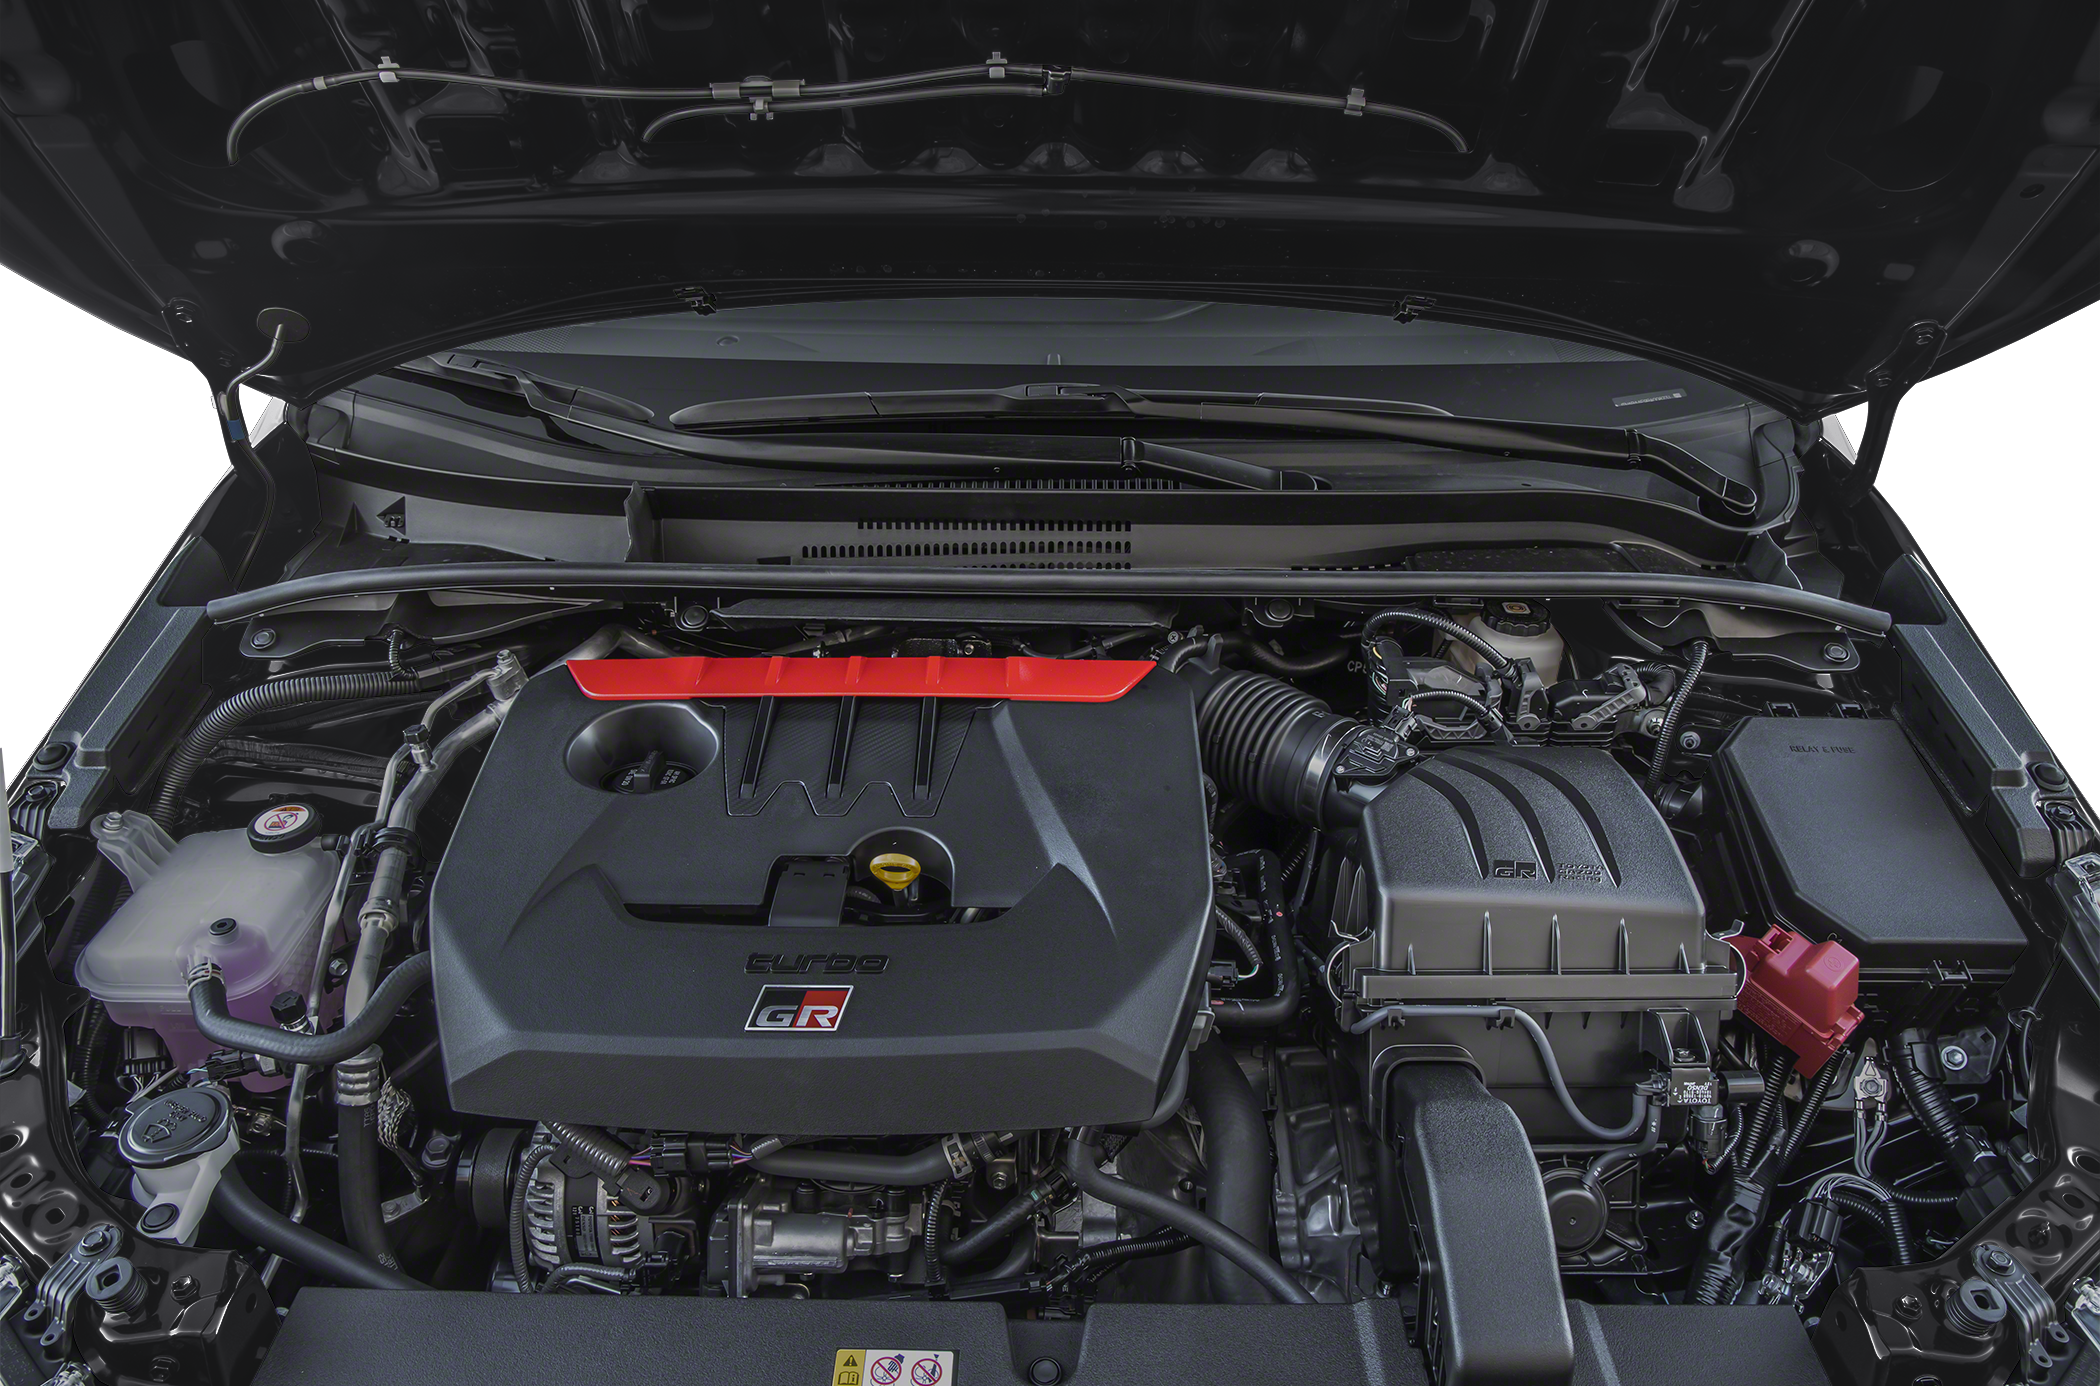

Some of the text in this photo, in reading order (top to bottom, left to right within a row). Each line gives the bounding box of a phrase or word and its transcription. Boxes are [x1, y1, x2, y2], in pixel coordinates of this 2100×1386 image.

[1789, 745, 1820, 753] RELAY
[1494, 863, 1537, 880] GR
[1556, 862, 1603, 871] TOYOTA
[744, 952, 890, 974] turbo
[755, 1004, 840, 1028] GR
